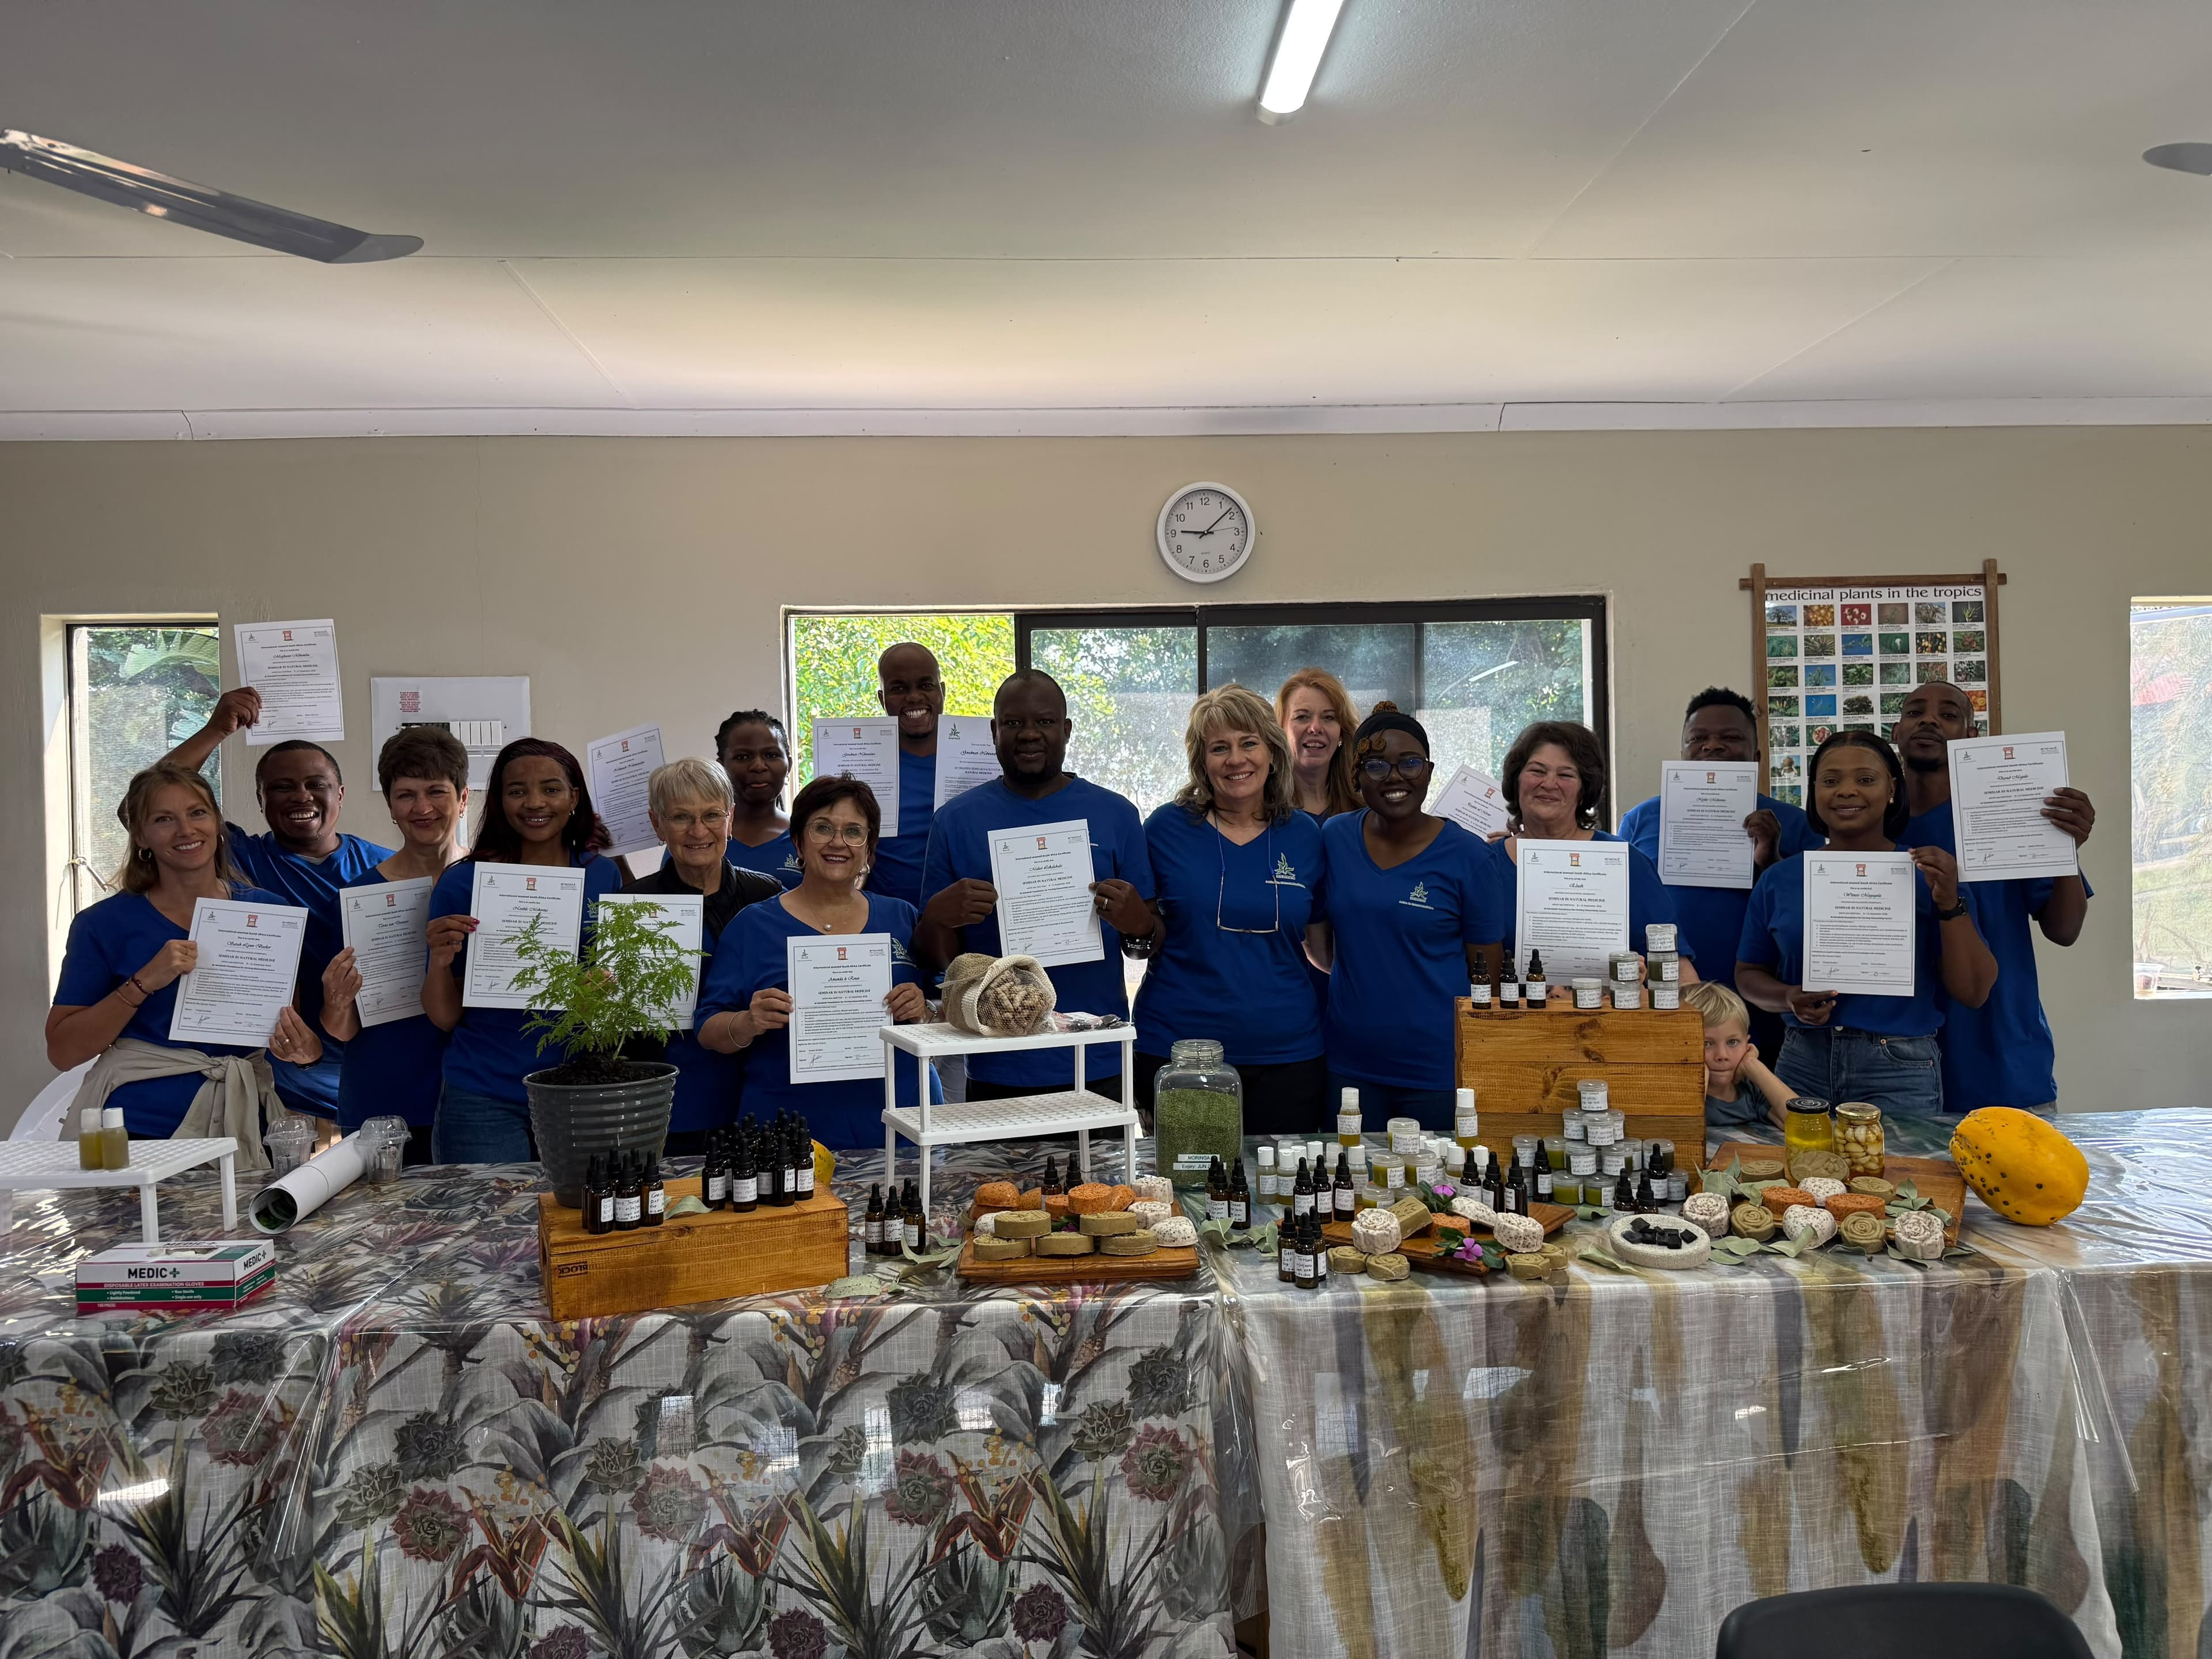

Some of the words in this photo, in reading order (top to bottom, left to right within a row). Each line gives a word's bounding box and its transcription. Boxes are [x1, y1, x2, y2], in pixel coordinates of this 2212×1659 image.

[1185, 502, 1193, 510] 11
[1175, 514, 1185, 522] 10
[1229, 512, 1234, 520] 2
[1171, 529, 1176, 537] 9
[1234, 528, 1240, 536] 3
[1176, 545, 1182, 553] 8
[1189, 556, 1195, 564] 7
[1203, 560, 1209, 568] 6
[1765, 589, 1834, 601] medicinal
[1840, 588, 1883, 601] plants
[1888, 588, 1900, 599] in
[1906, 588, 1928, 598] the
[1934, 587, 1982, 599] tropics
[557, 1264, 588, 1274] BLOCK
